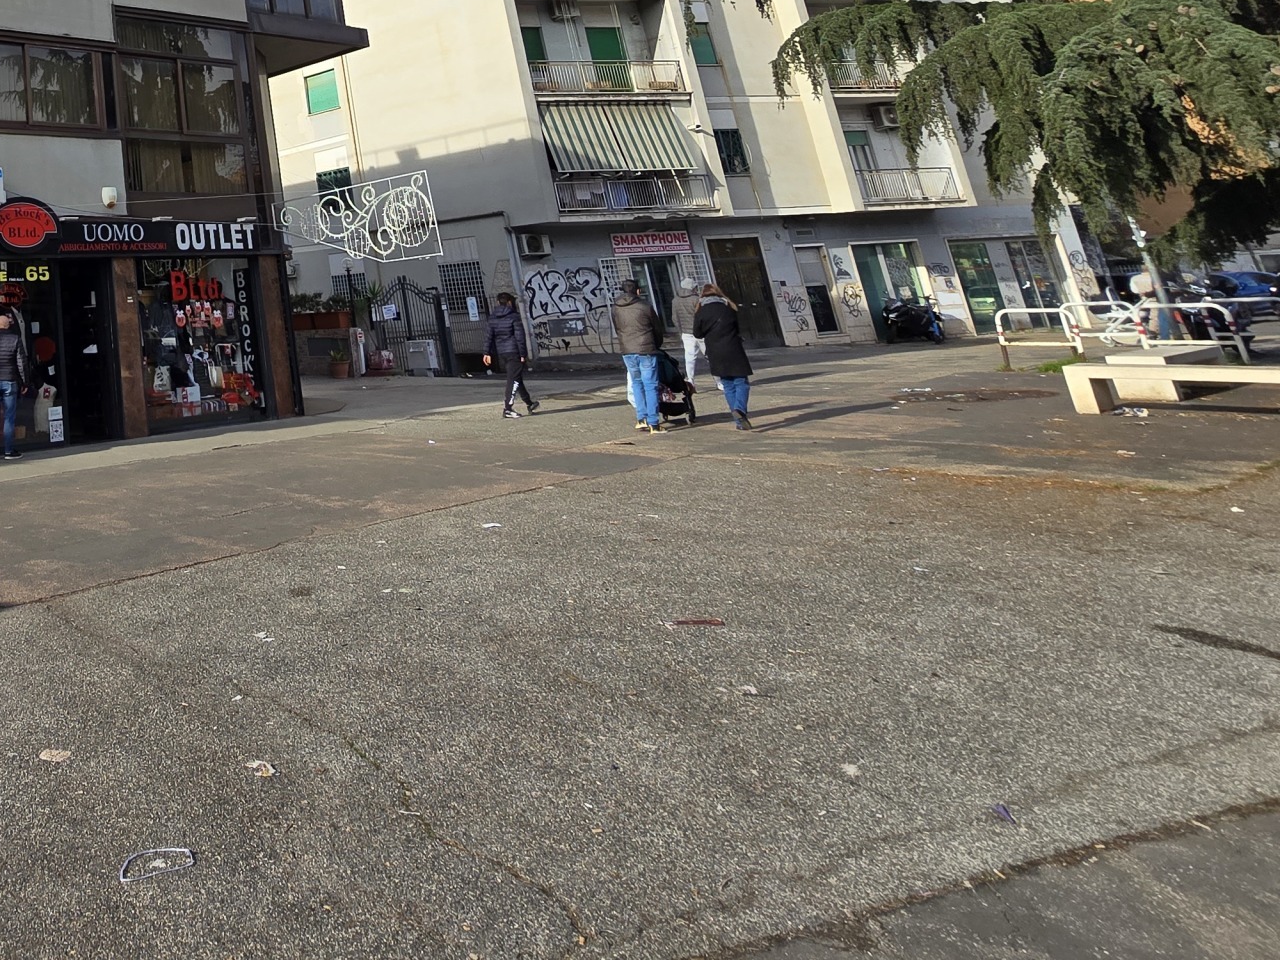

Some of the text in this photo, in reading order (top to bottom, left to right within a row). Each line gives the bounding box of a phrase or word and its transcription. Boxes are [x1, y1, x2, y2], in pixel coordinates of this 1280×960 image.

[8, 227, 40, 238] BLtd.
[82, 223, 254, 251] UOMO OUTLET
[613, 232, 688, 246] SMARTPHONE
[59, 242, 166, 252] ABBIGLIAMENTO & ACCESSORI
[25, 266, 50, 282] 65
[170, 270, 225, 301] BLtd.
